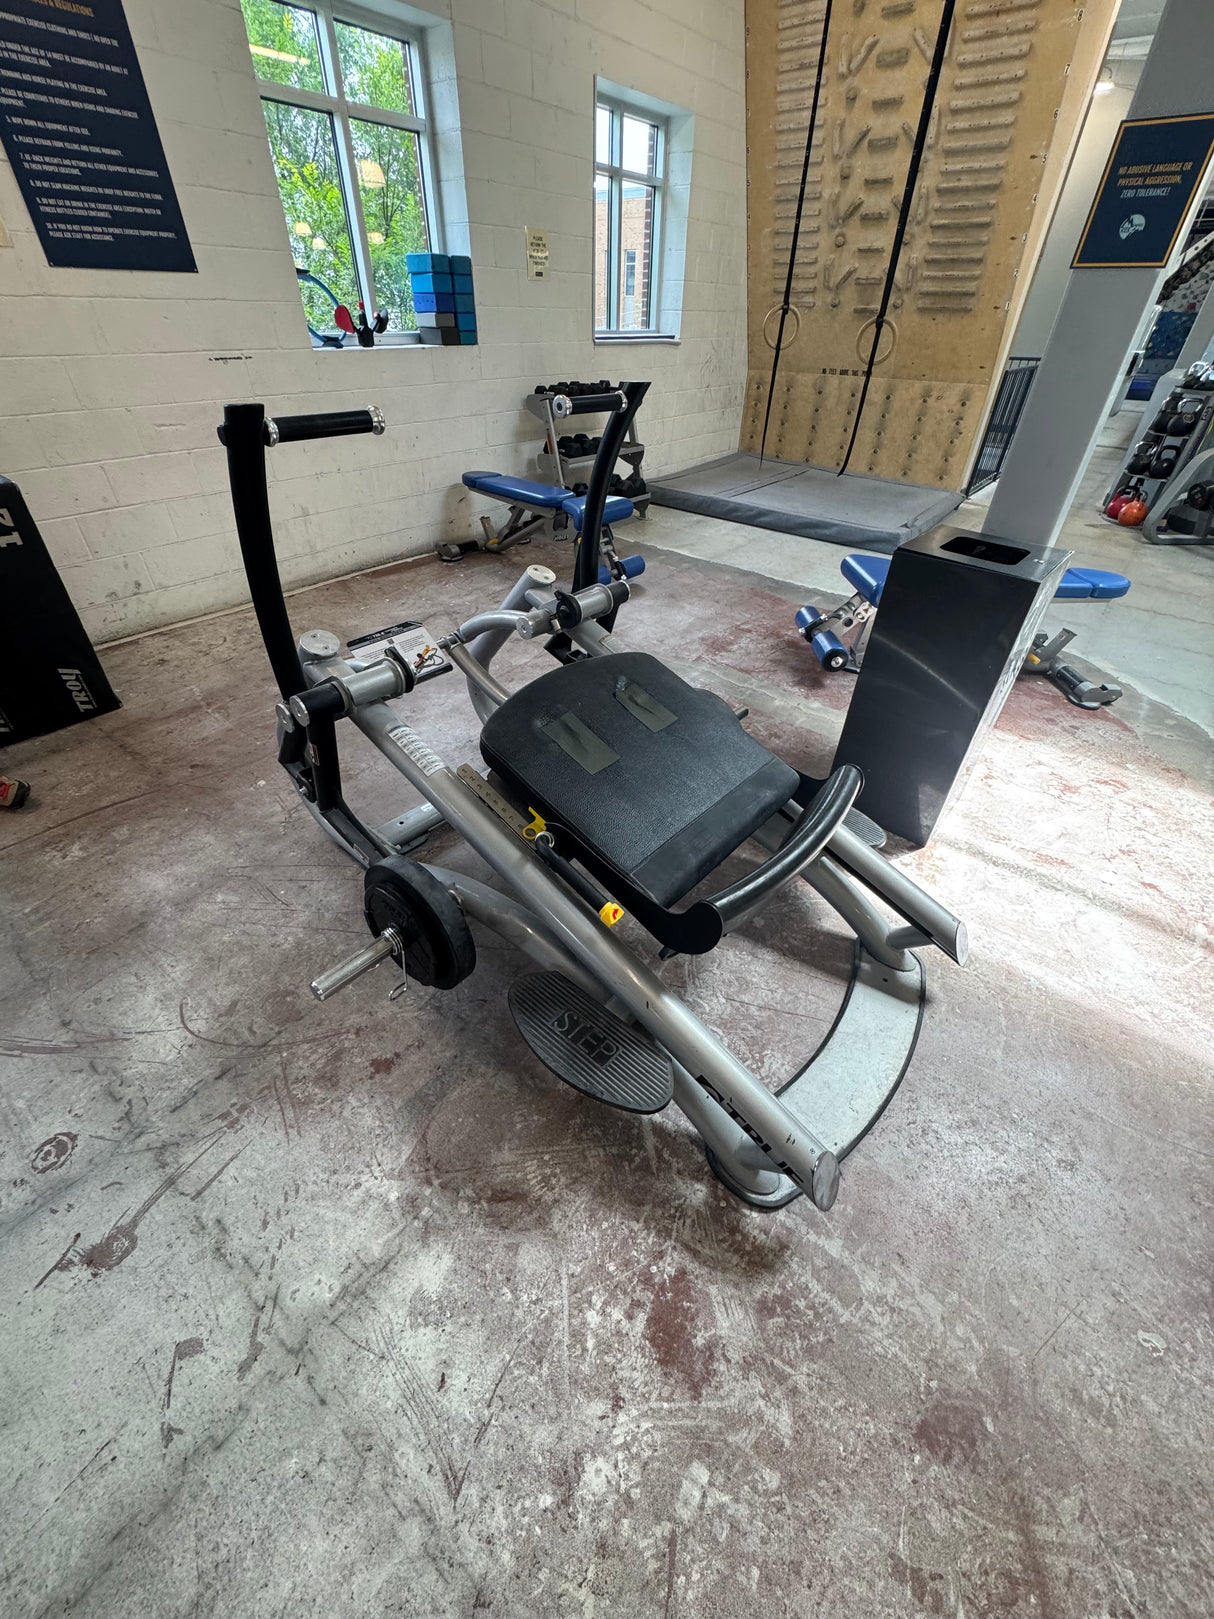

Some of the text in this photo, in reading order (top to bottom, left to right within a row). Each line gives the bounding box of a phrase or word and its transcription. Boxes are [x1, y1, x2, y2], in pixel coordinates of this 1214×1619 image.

[1126, 164, 1153, 174] ABUSIVE
[1152, 162, 1184, 173] LANGUAGE
[1183, 161, 1193, 171] OR
[1117, 177, 1145, 187] PHYSICAL
[1120, 186, 1171, 198] ZERO TOLERANCE!
[57, 668, 94, 713] TROY
[553, 1010, 618, 1059] STEP
